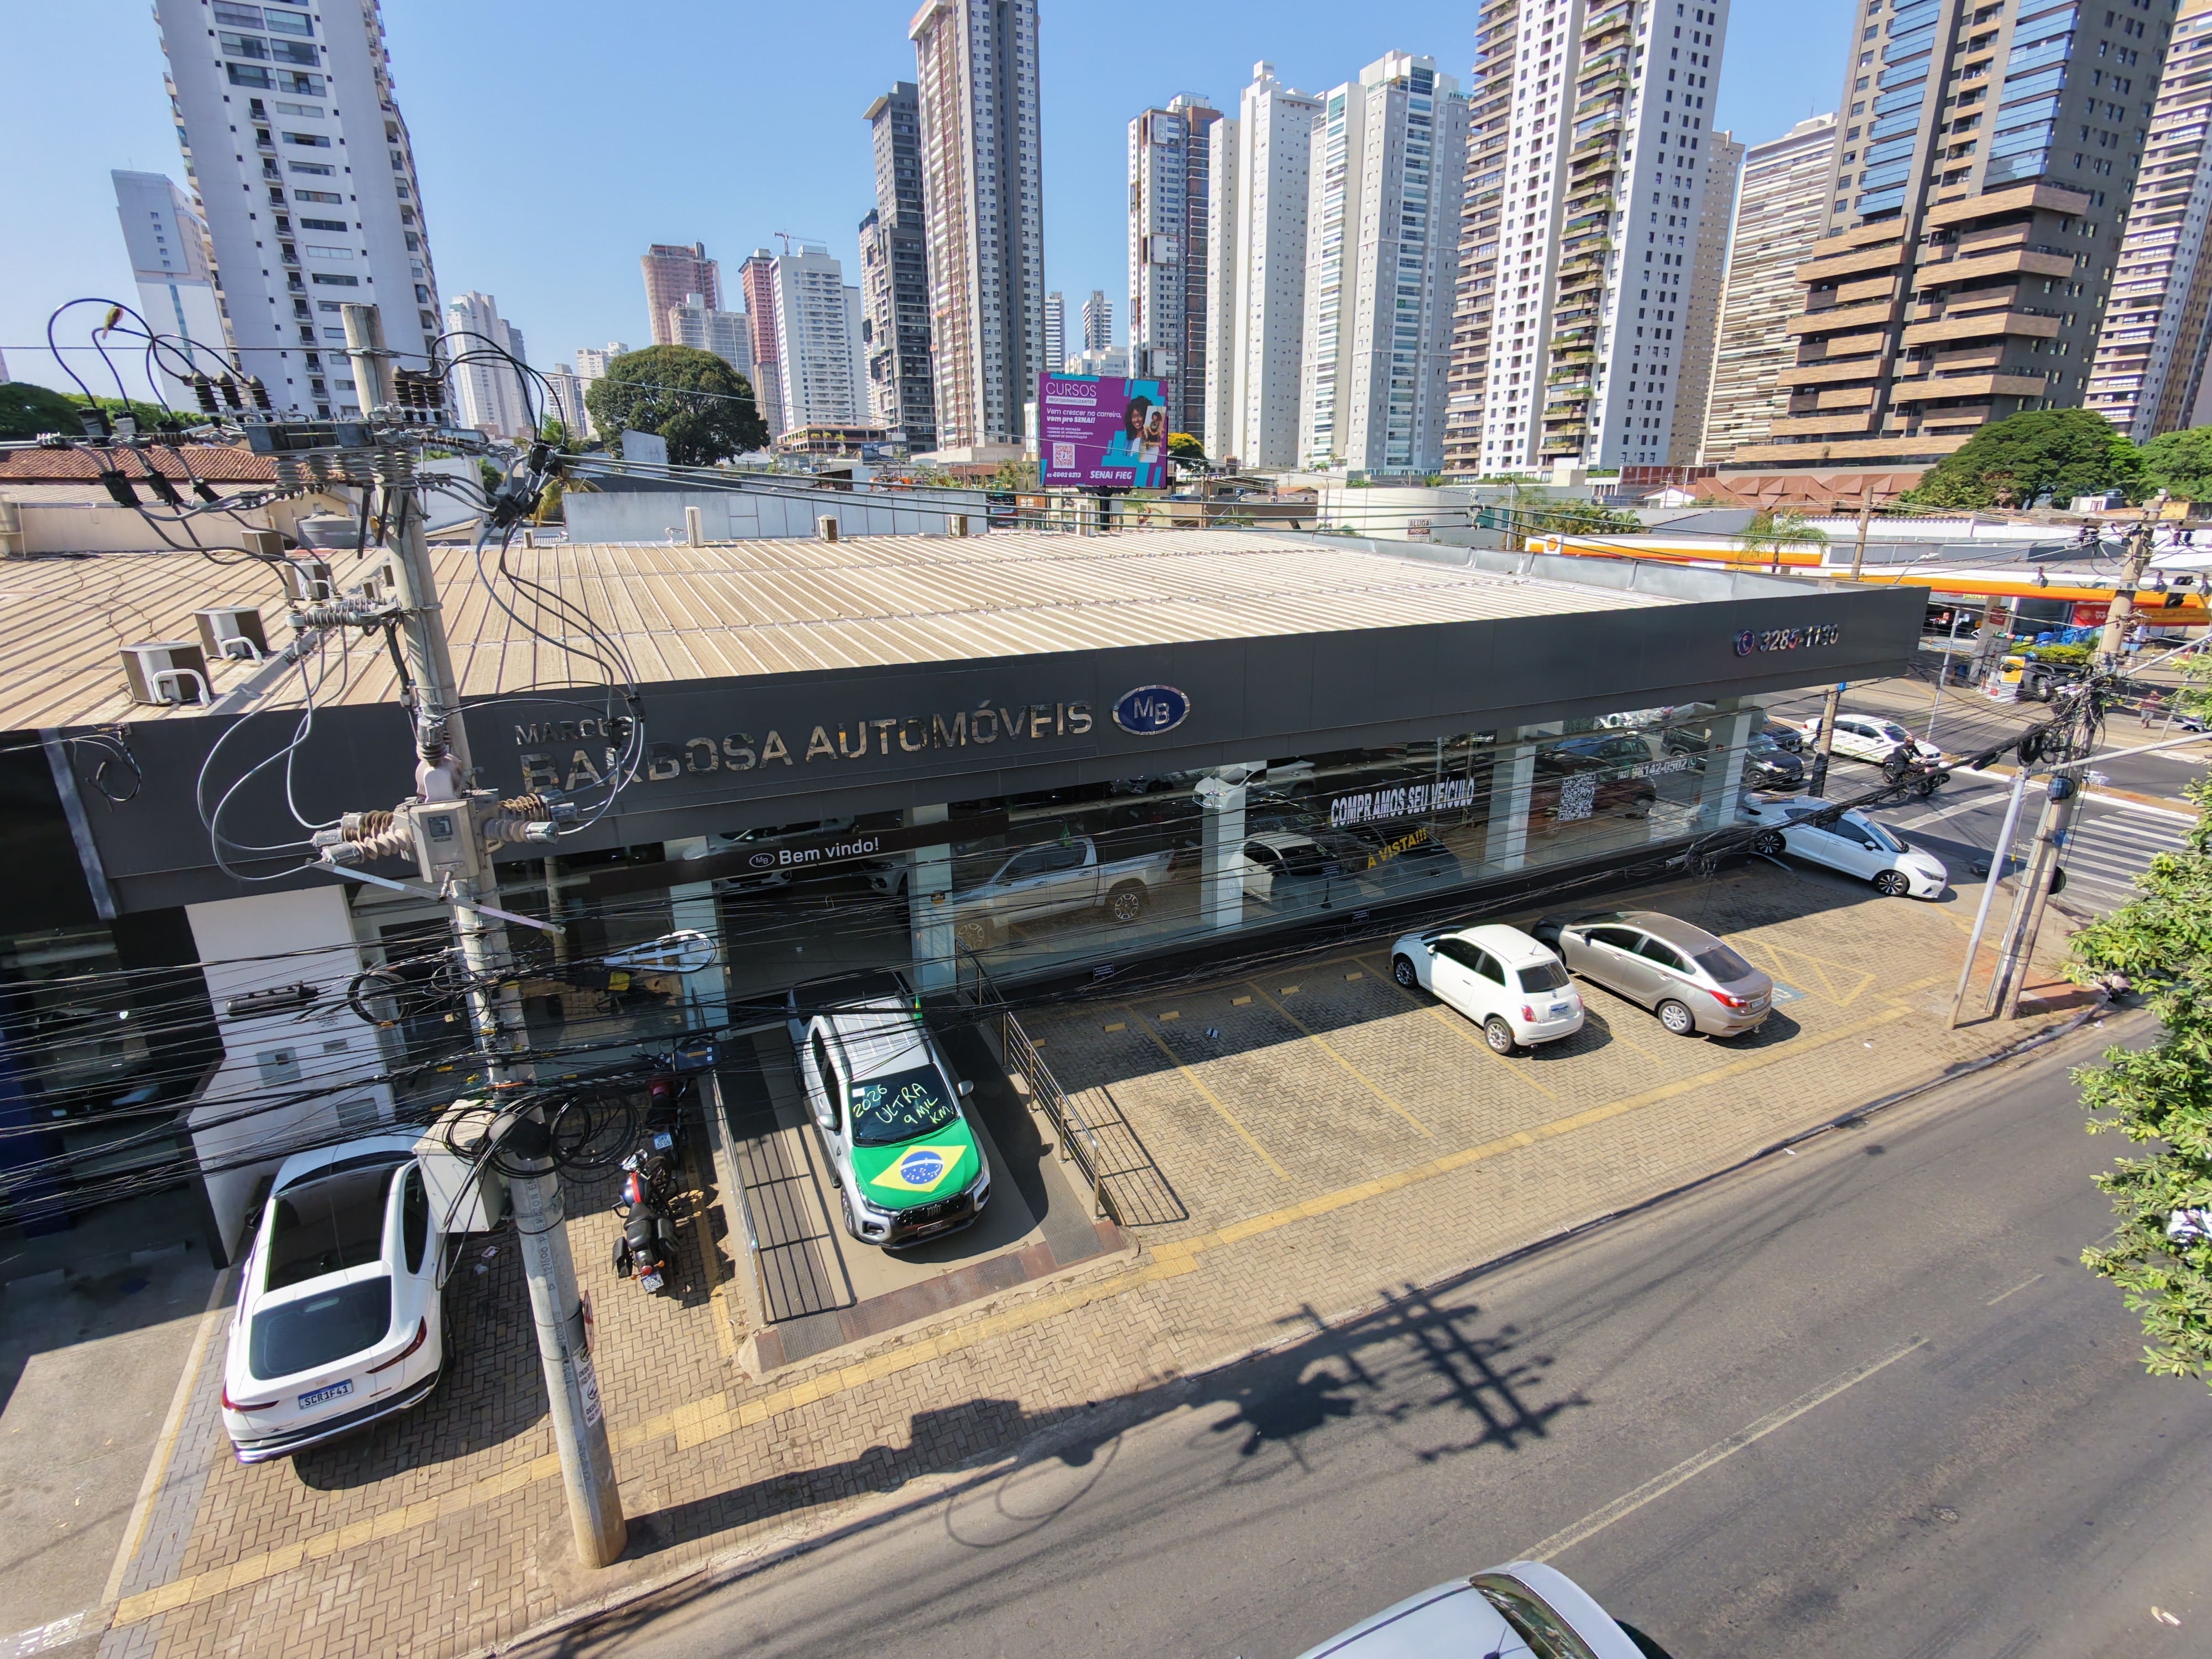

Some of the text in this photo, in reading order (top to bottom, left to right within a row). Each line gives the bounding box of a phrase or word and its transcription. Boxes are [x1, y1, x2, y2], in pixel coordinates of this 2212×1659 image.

[1046, 382, 1097, 397] CURSOS
[1133, 695, 1170, 724] MB
[520, 699, 1093, 794] BARBOSA AUTOMÓVEIS
[1331, 787, 1406, 828] COMPRAMOS
[1407, 785, 1428, 815] SEU
[1431, 776, 1474, 811] VEÍCULO
[779, 837, 879, 865] Bem vindo!
[1378, 827, 1427, 861] VISTA!!!
[853, 1084, 888, 1118] 2026
[875, 1083, 927, 1123] ULTRA
[916, 1098, 938, 1118] MIL
[305, 1385, 348, 1406] SCR1F41
